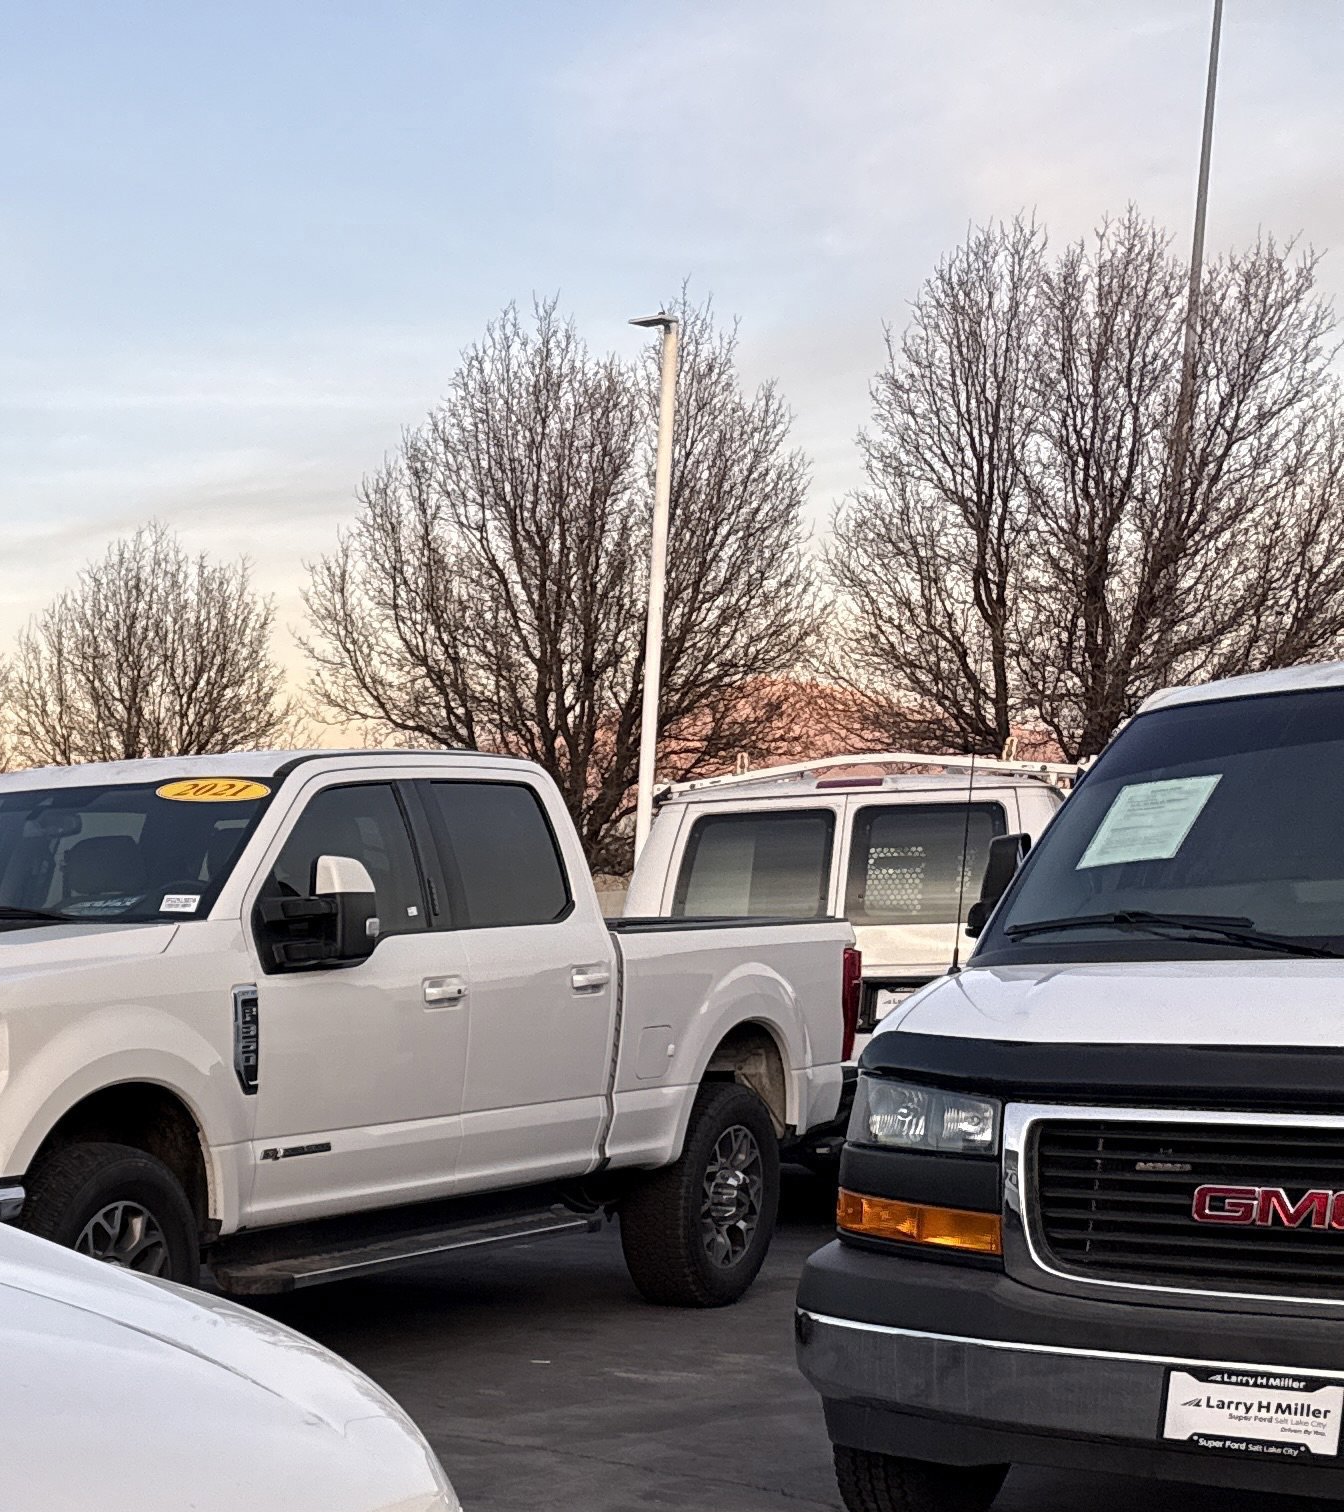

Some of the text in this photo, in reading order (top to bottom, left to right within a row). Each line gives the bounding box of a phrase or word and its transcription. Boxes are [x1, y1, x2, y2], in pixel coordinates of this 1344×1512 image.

[172, 783, 254, 797] 2021
[1192, 1184, 1344, 1230] GM
[1223, 1373, 1307, 1389] Larry H Miller
[1206, 1396, 1331, 1420] Larry H Miller
[1228, 1413, 1327, 1430] Super Ford Salt Lake City
[1198, 1438, 1299, 1457] Super Ford Salt Lake City
